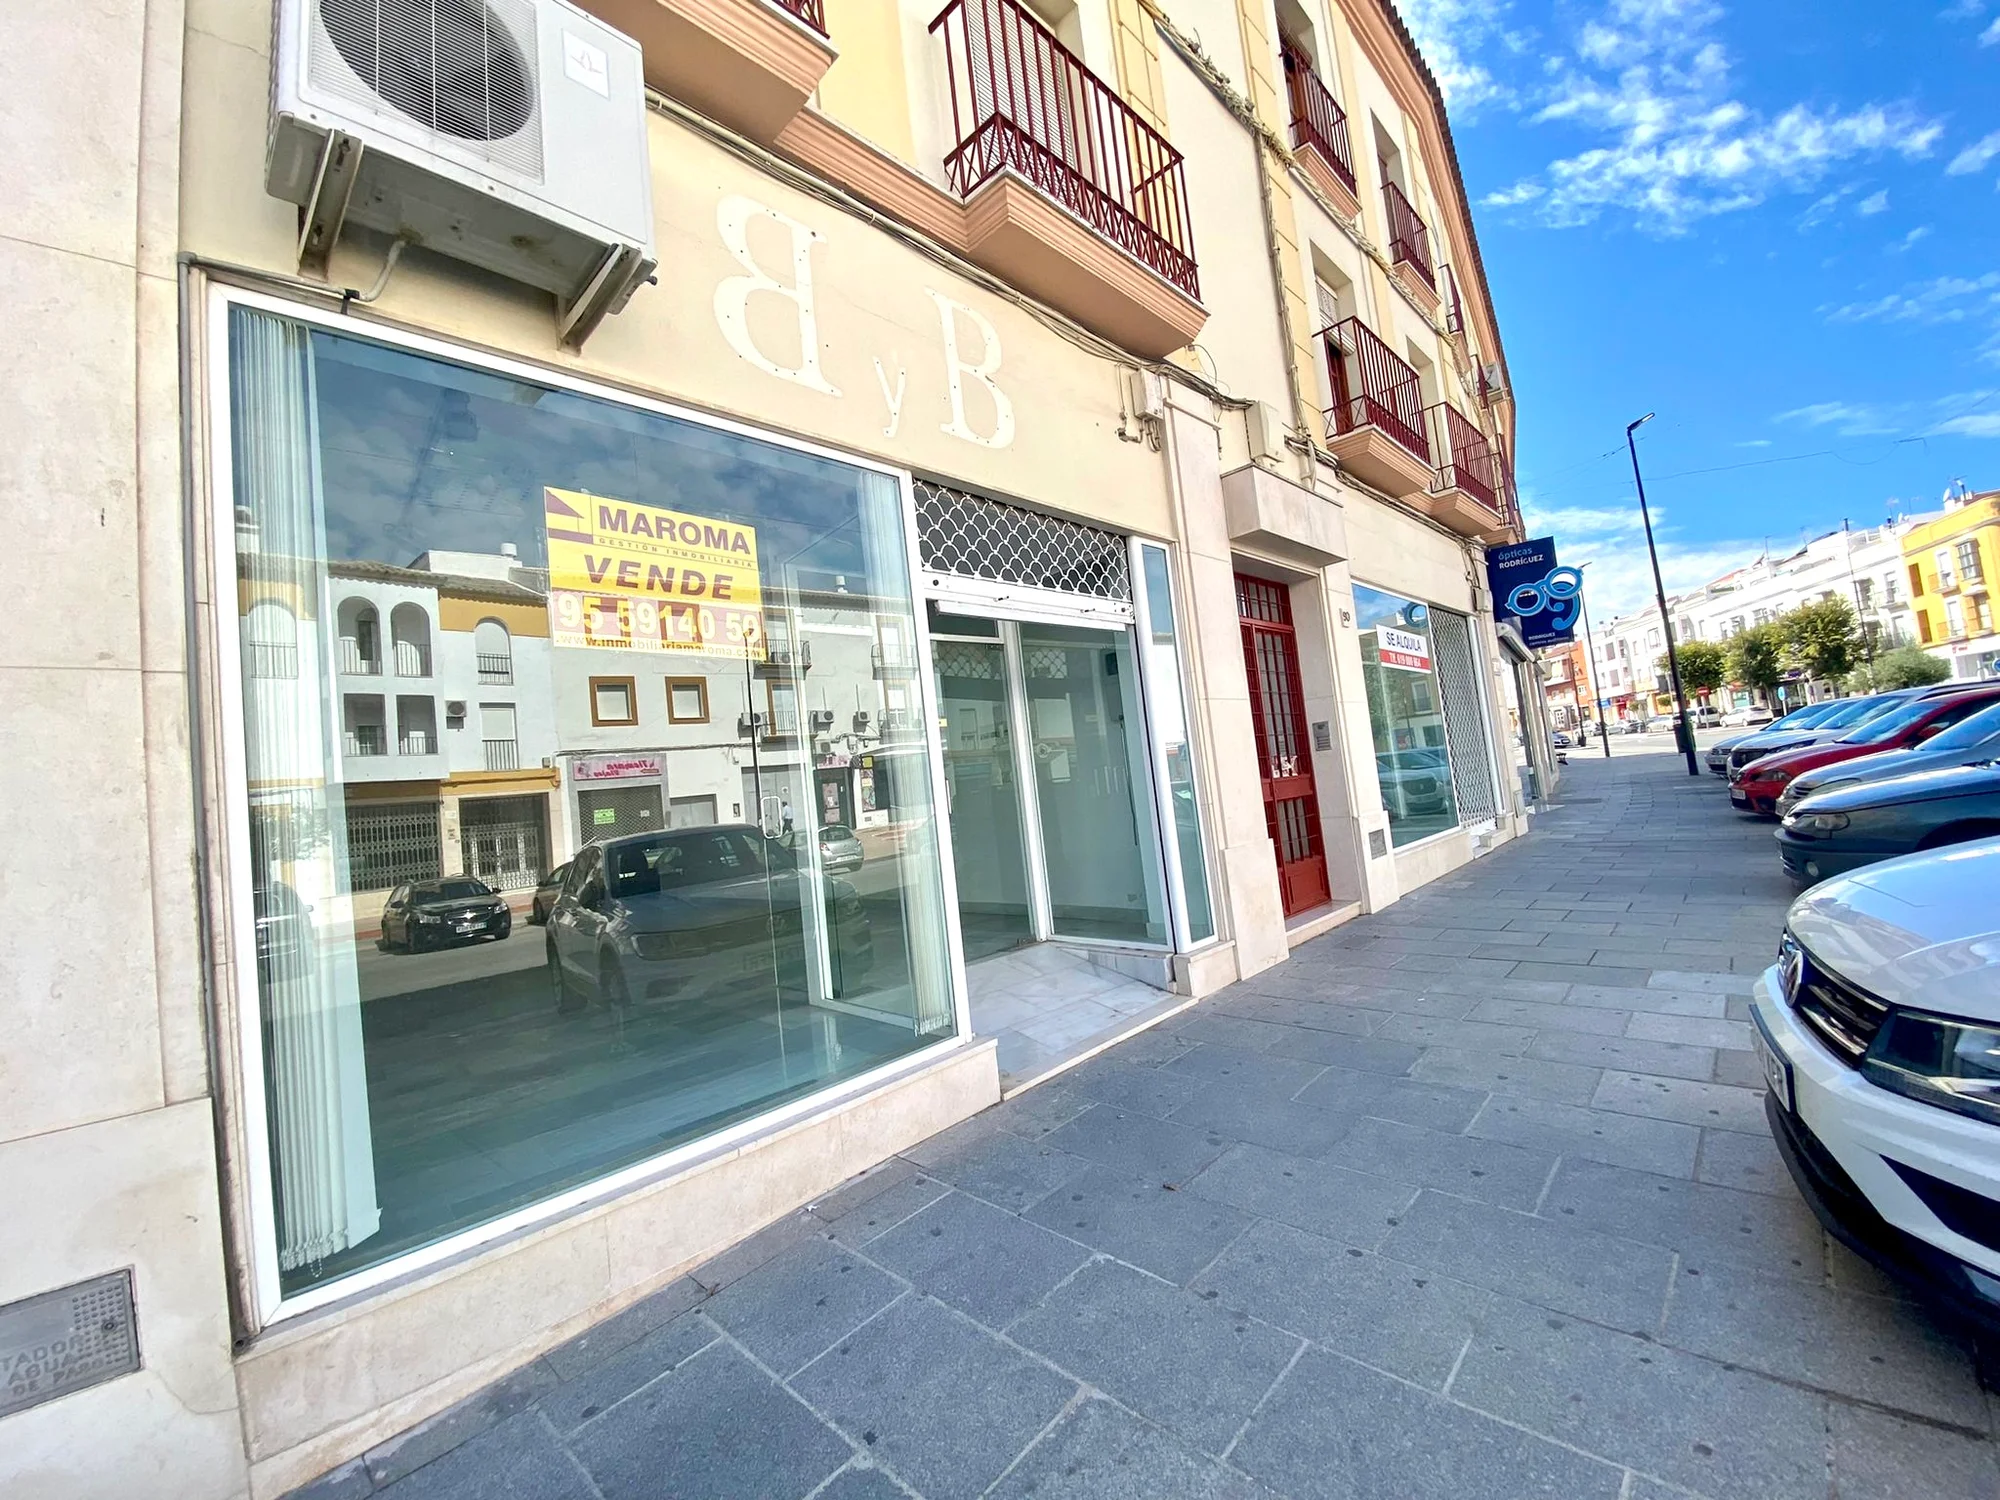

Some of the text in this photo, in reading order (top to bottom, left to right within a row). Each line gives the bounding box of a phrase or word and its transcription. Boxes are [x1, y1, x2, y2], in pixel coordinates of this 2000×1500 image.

[873, 356, 906, 438] y
[924, 285, 1016, 449] B
[598, 505, 751, 555] MAROMA
[599, 538, 753, 568] GESTIÓN INMOBILIARIA
[1498, 547, 1533, 561] ópticas
[1499, 554, 1544, 570] RODRÍGUEZ
[584, 554, 733, 600] VENDE
[557, 593, 604, 631] 95
[1385, 631, 1422, 652] SE ALQUILA
[8, 1353, 80, 1386] AGUA
